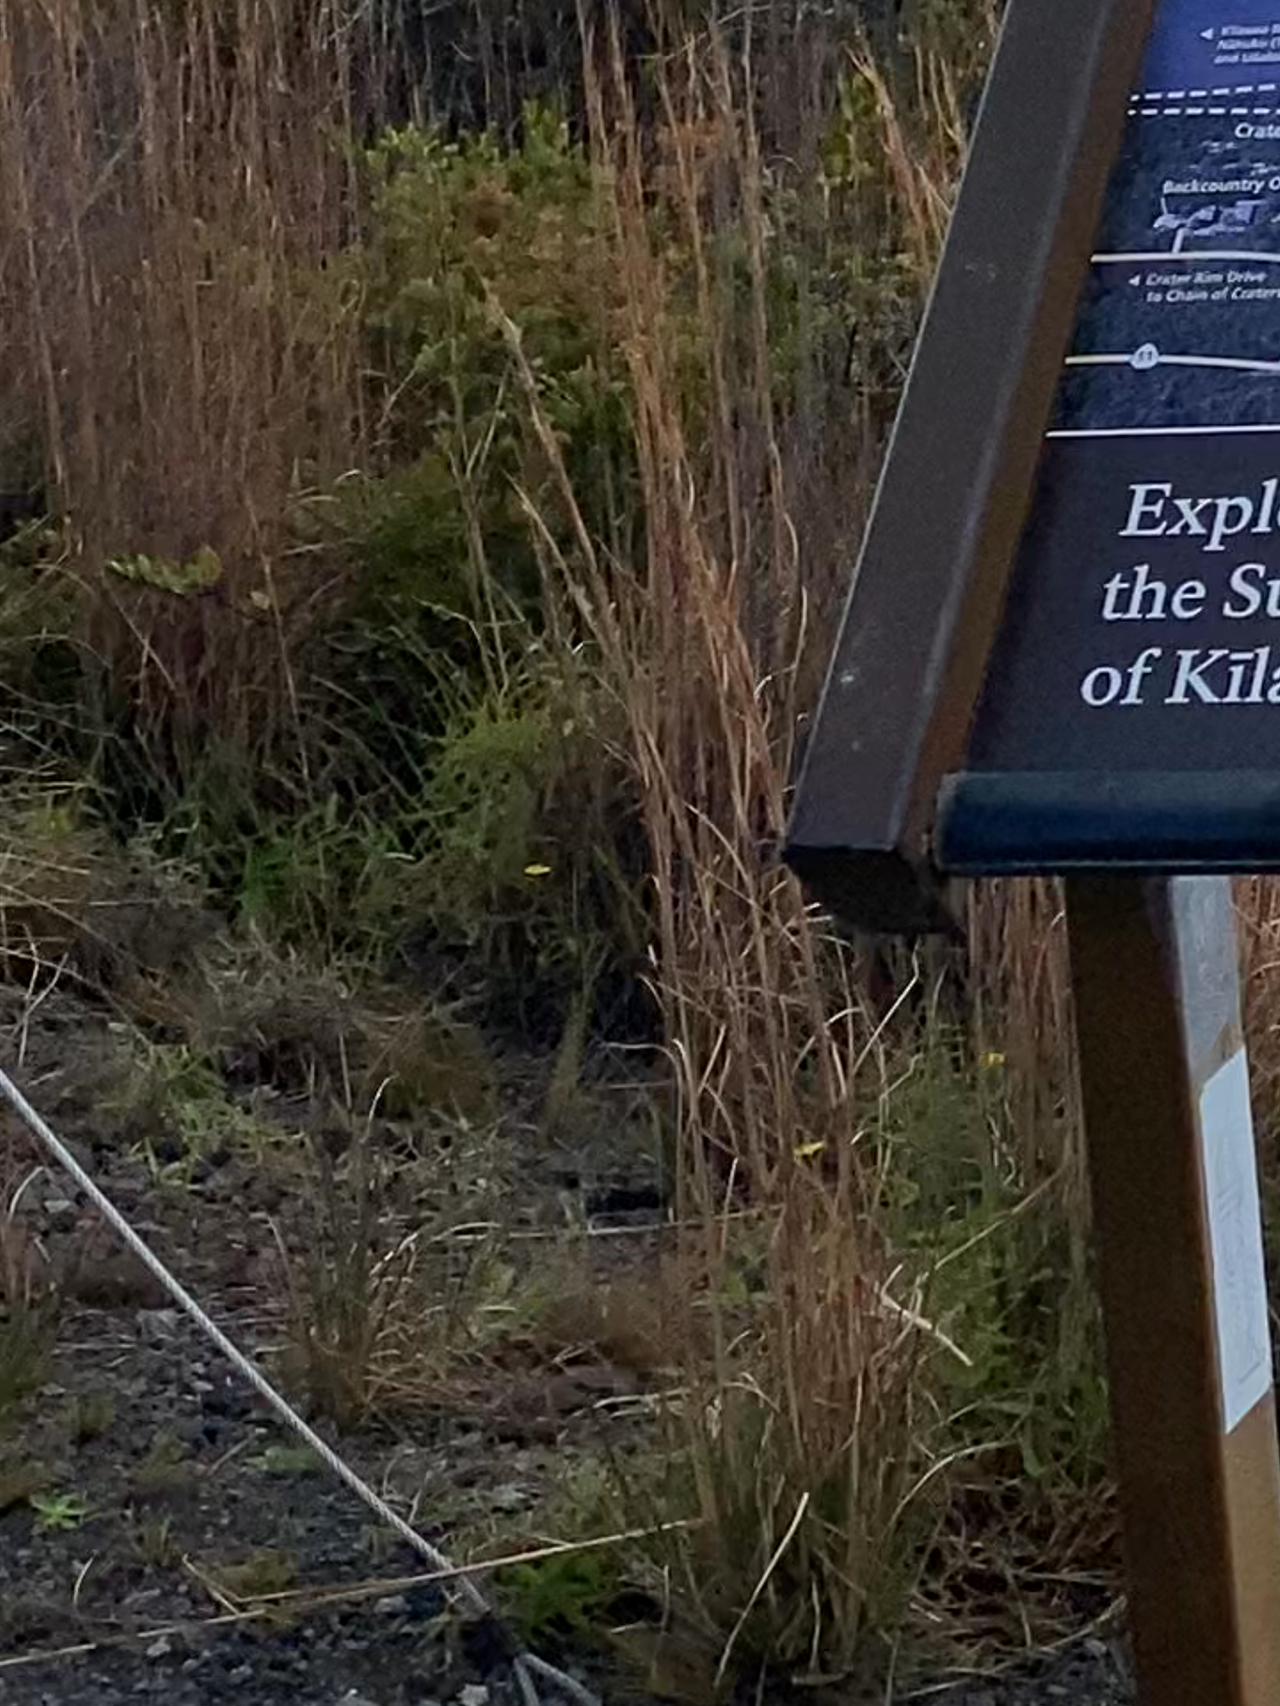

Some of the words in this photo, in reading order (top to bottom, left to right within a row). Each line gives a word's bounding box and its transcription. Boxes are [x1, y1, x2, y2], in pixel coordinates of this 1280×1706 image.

[1163, 178, 1264, 194] Backcountry
[1102, 564, 1205, 620] the
[1081, 647, 1162, 706] of
